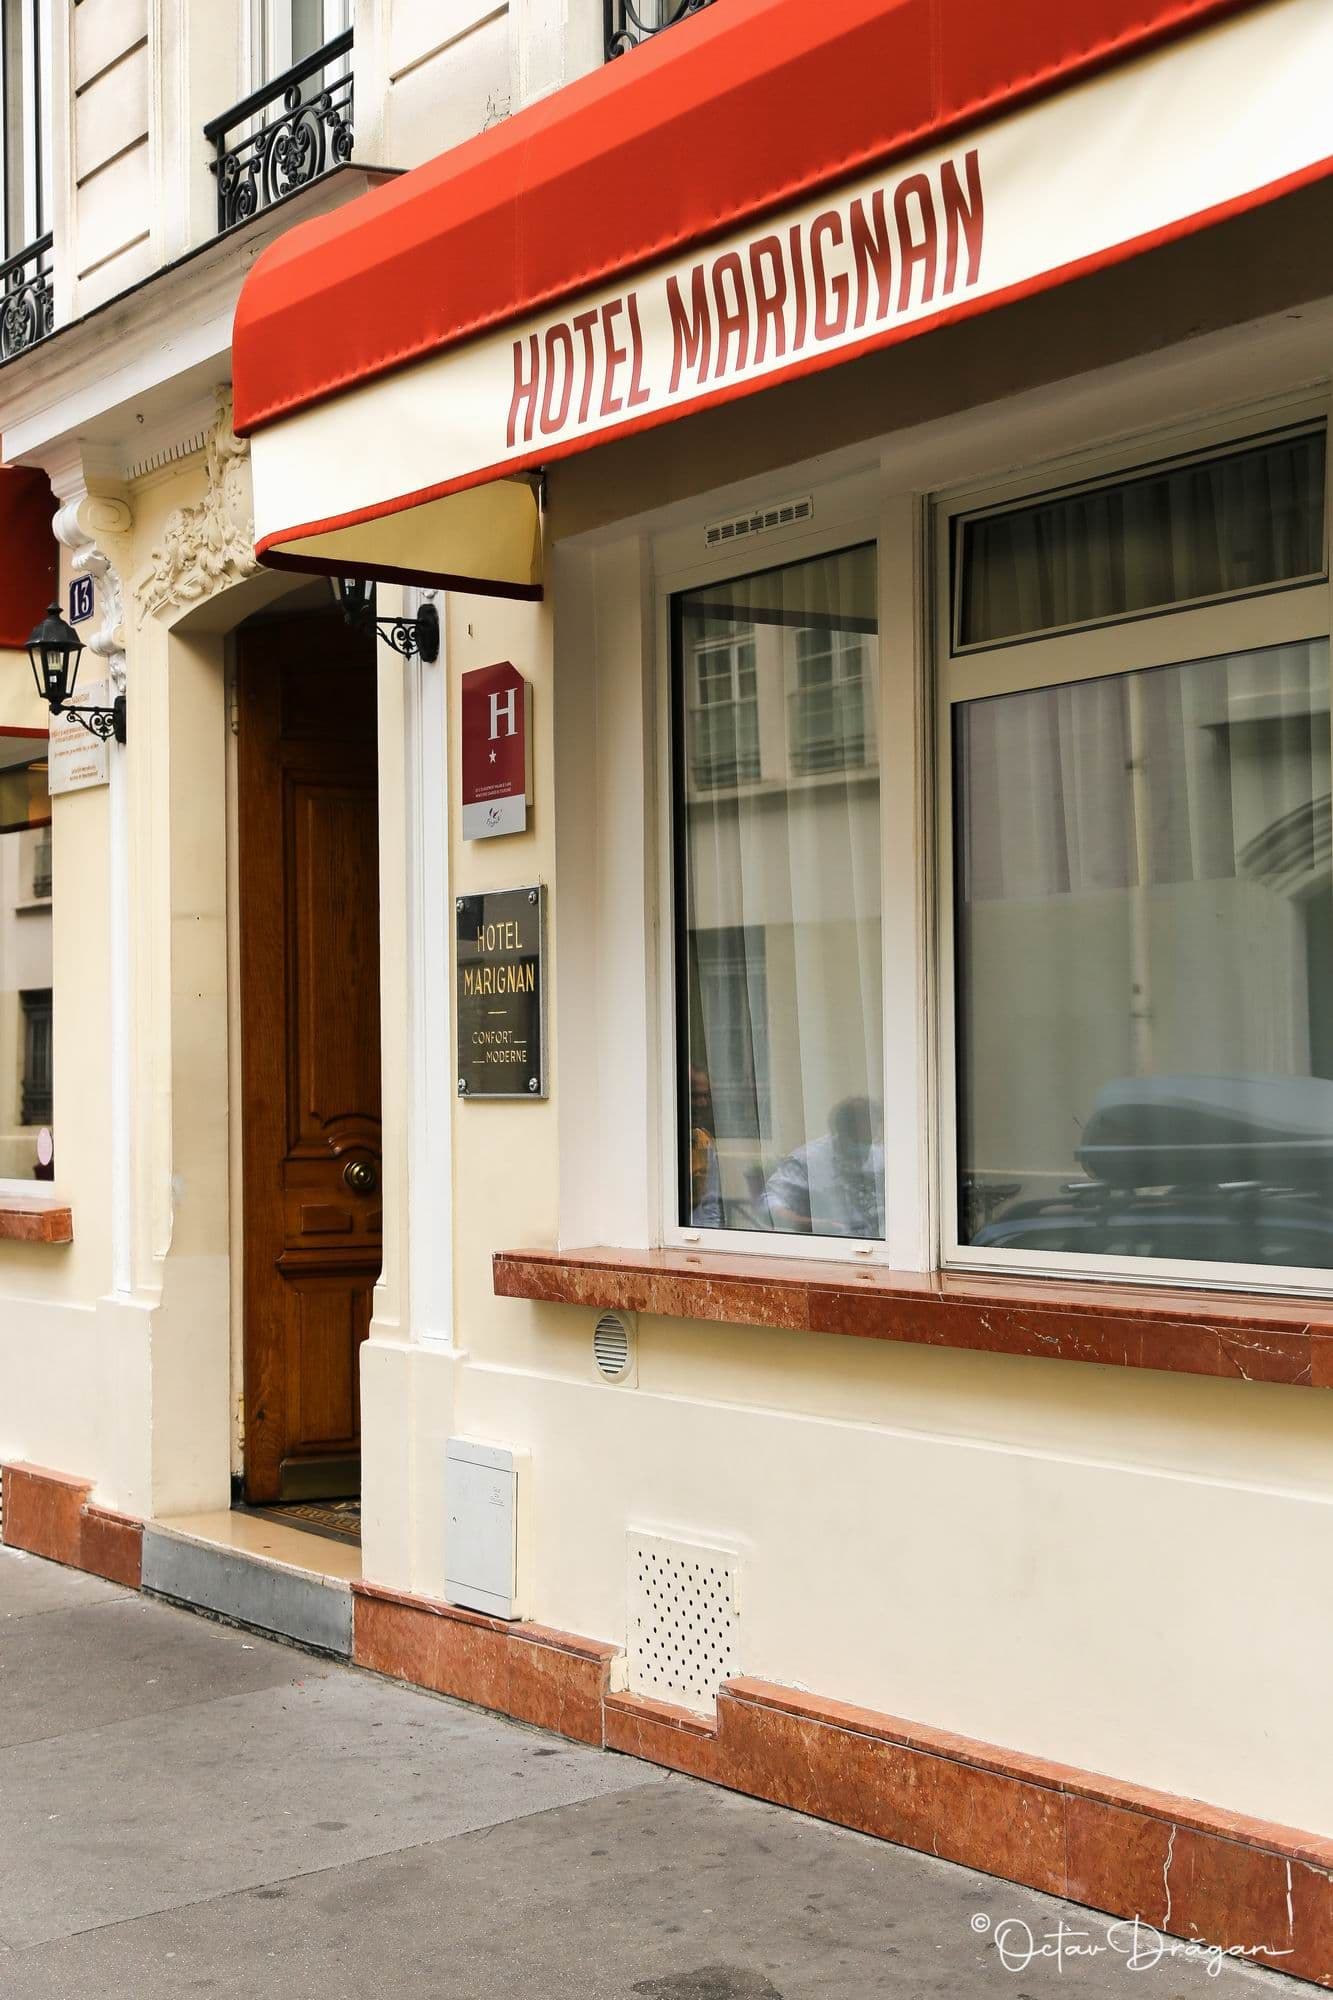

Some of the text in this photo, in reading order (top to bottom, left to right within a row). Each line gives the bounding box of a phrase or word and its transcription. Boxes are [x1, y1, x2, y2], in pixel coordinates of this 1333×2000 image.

[506, 148, 985, 449] HOTEL MARIGNAN
[73, 579, 91, 619] 13
[488, 687, 518, 741] H
[477, 920, 523, 952] HOTEL
[464, 963, 535, 996] MARIGNAN
[472, 1030, 513, 1045] CONFORT
[486, 1050, 527, 1063] MODERNE
